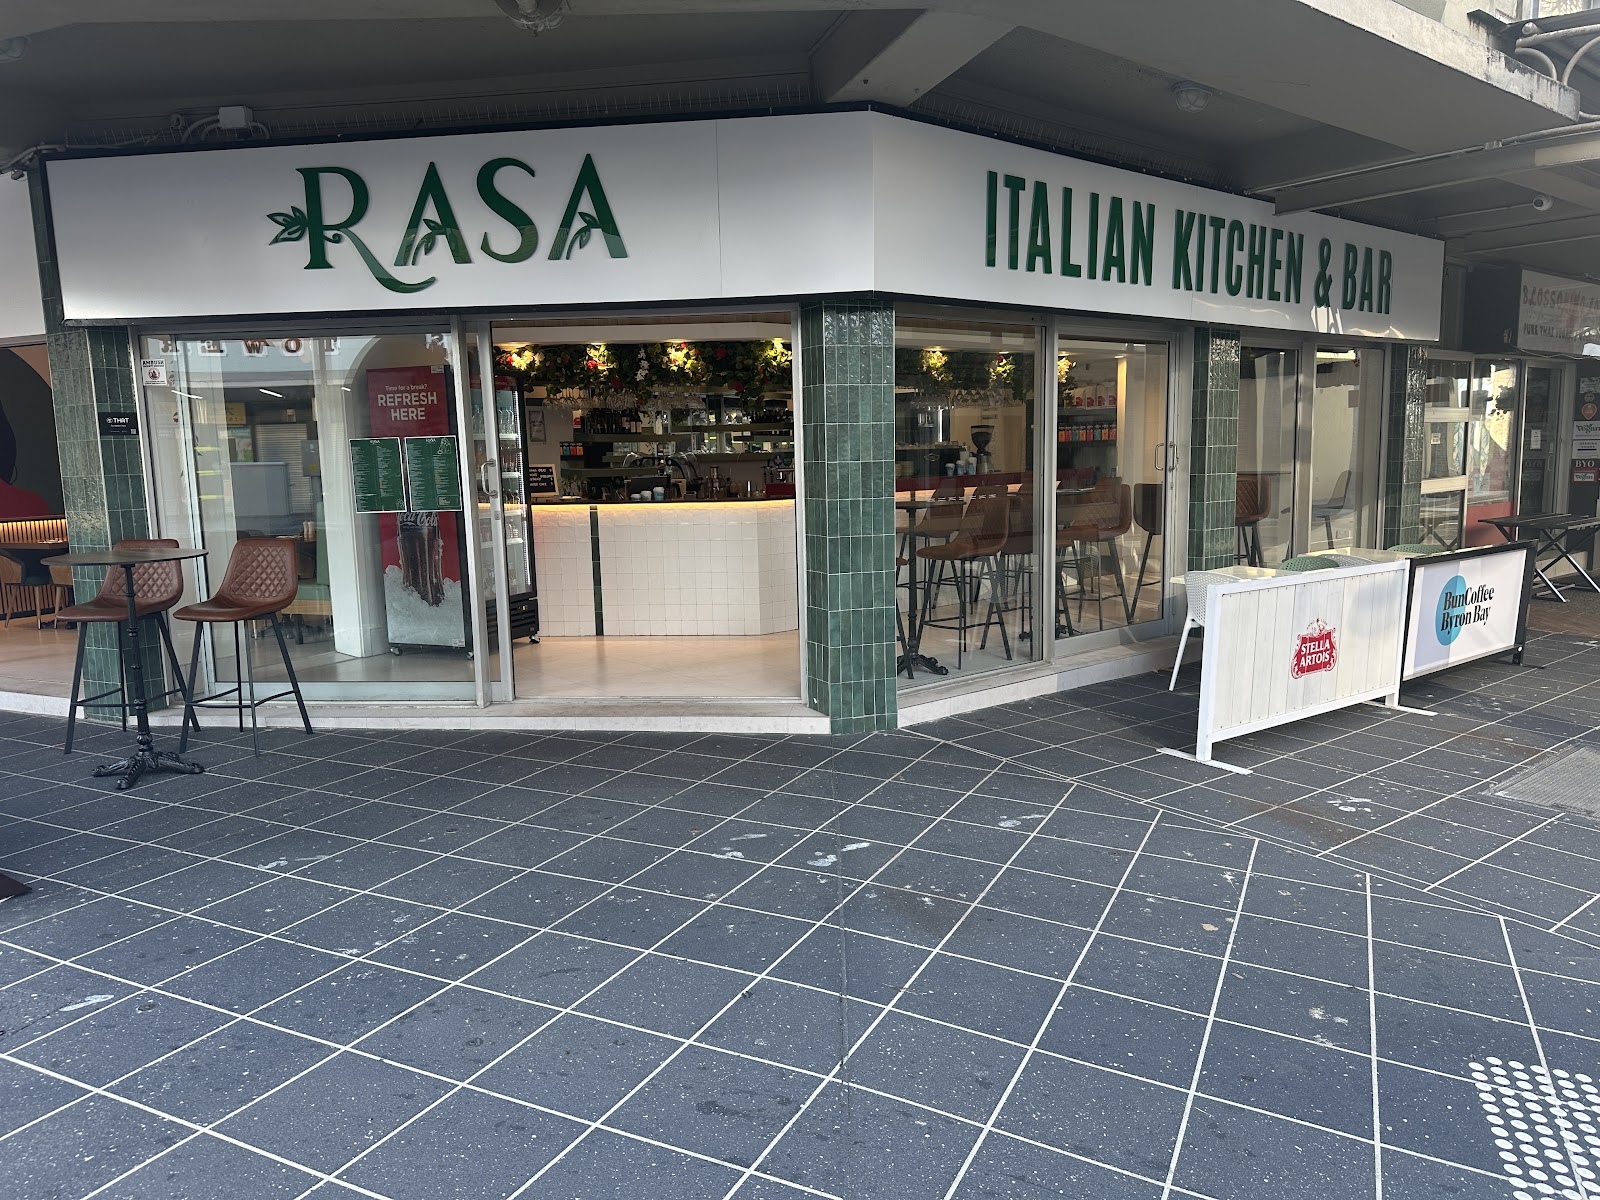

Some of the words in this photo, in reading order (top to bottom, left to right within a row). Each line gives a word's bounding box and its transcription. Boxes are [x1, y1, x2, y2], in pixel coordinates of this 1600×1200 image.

[290, 153, 629, 294] RASA
[984, 170, 1156, 287] ITALIAN
[1172, 208, 1305, 304] KITCHEN
[1314, 238, 1333, 309] &
[1341, 242, 1394, 315] BAR
[1523, 323, 1538, 336] PURE
[377, 391, 438, 407] REFRESH
[391, 407, 426, 421] HERE
[1575, 460, 1595, 468] BYO
[1443, 584, 1495, 611] BunCoffee
[1440, 611, 1472, 635] Byron
[1472, 605, 1491, 626] Bay
[1300, 639, 1331, 655] STELLA
[1299, 651, 1330, 667] ARTOIS
